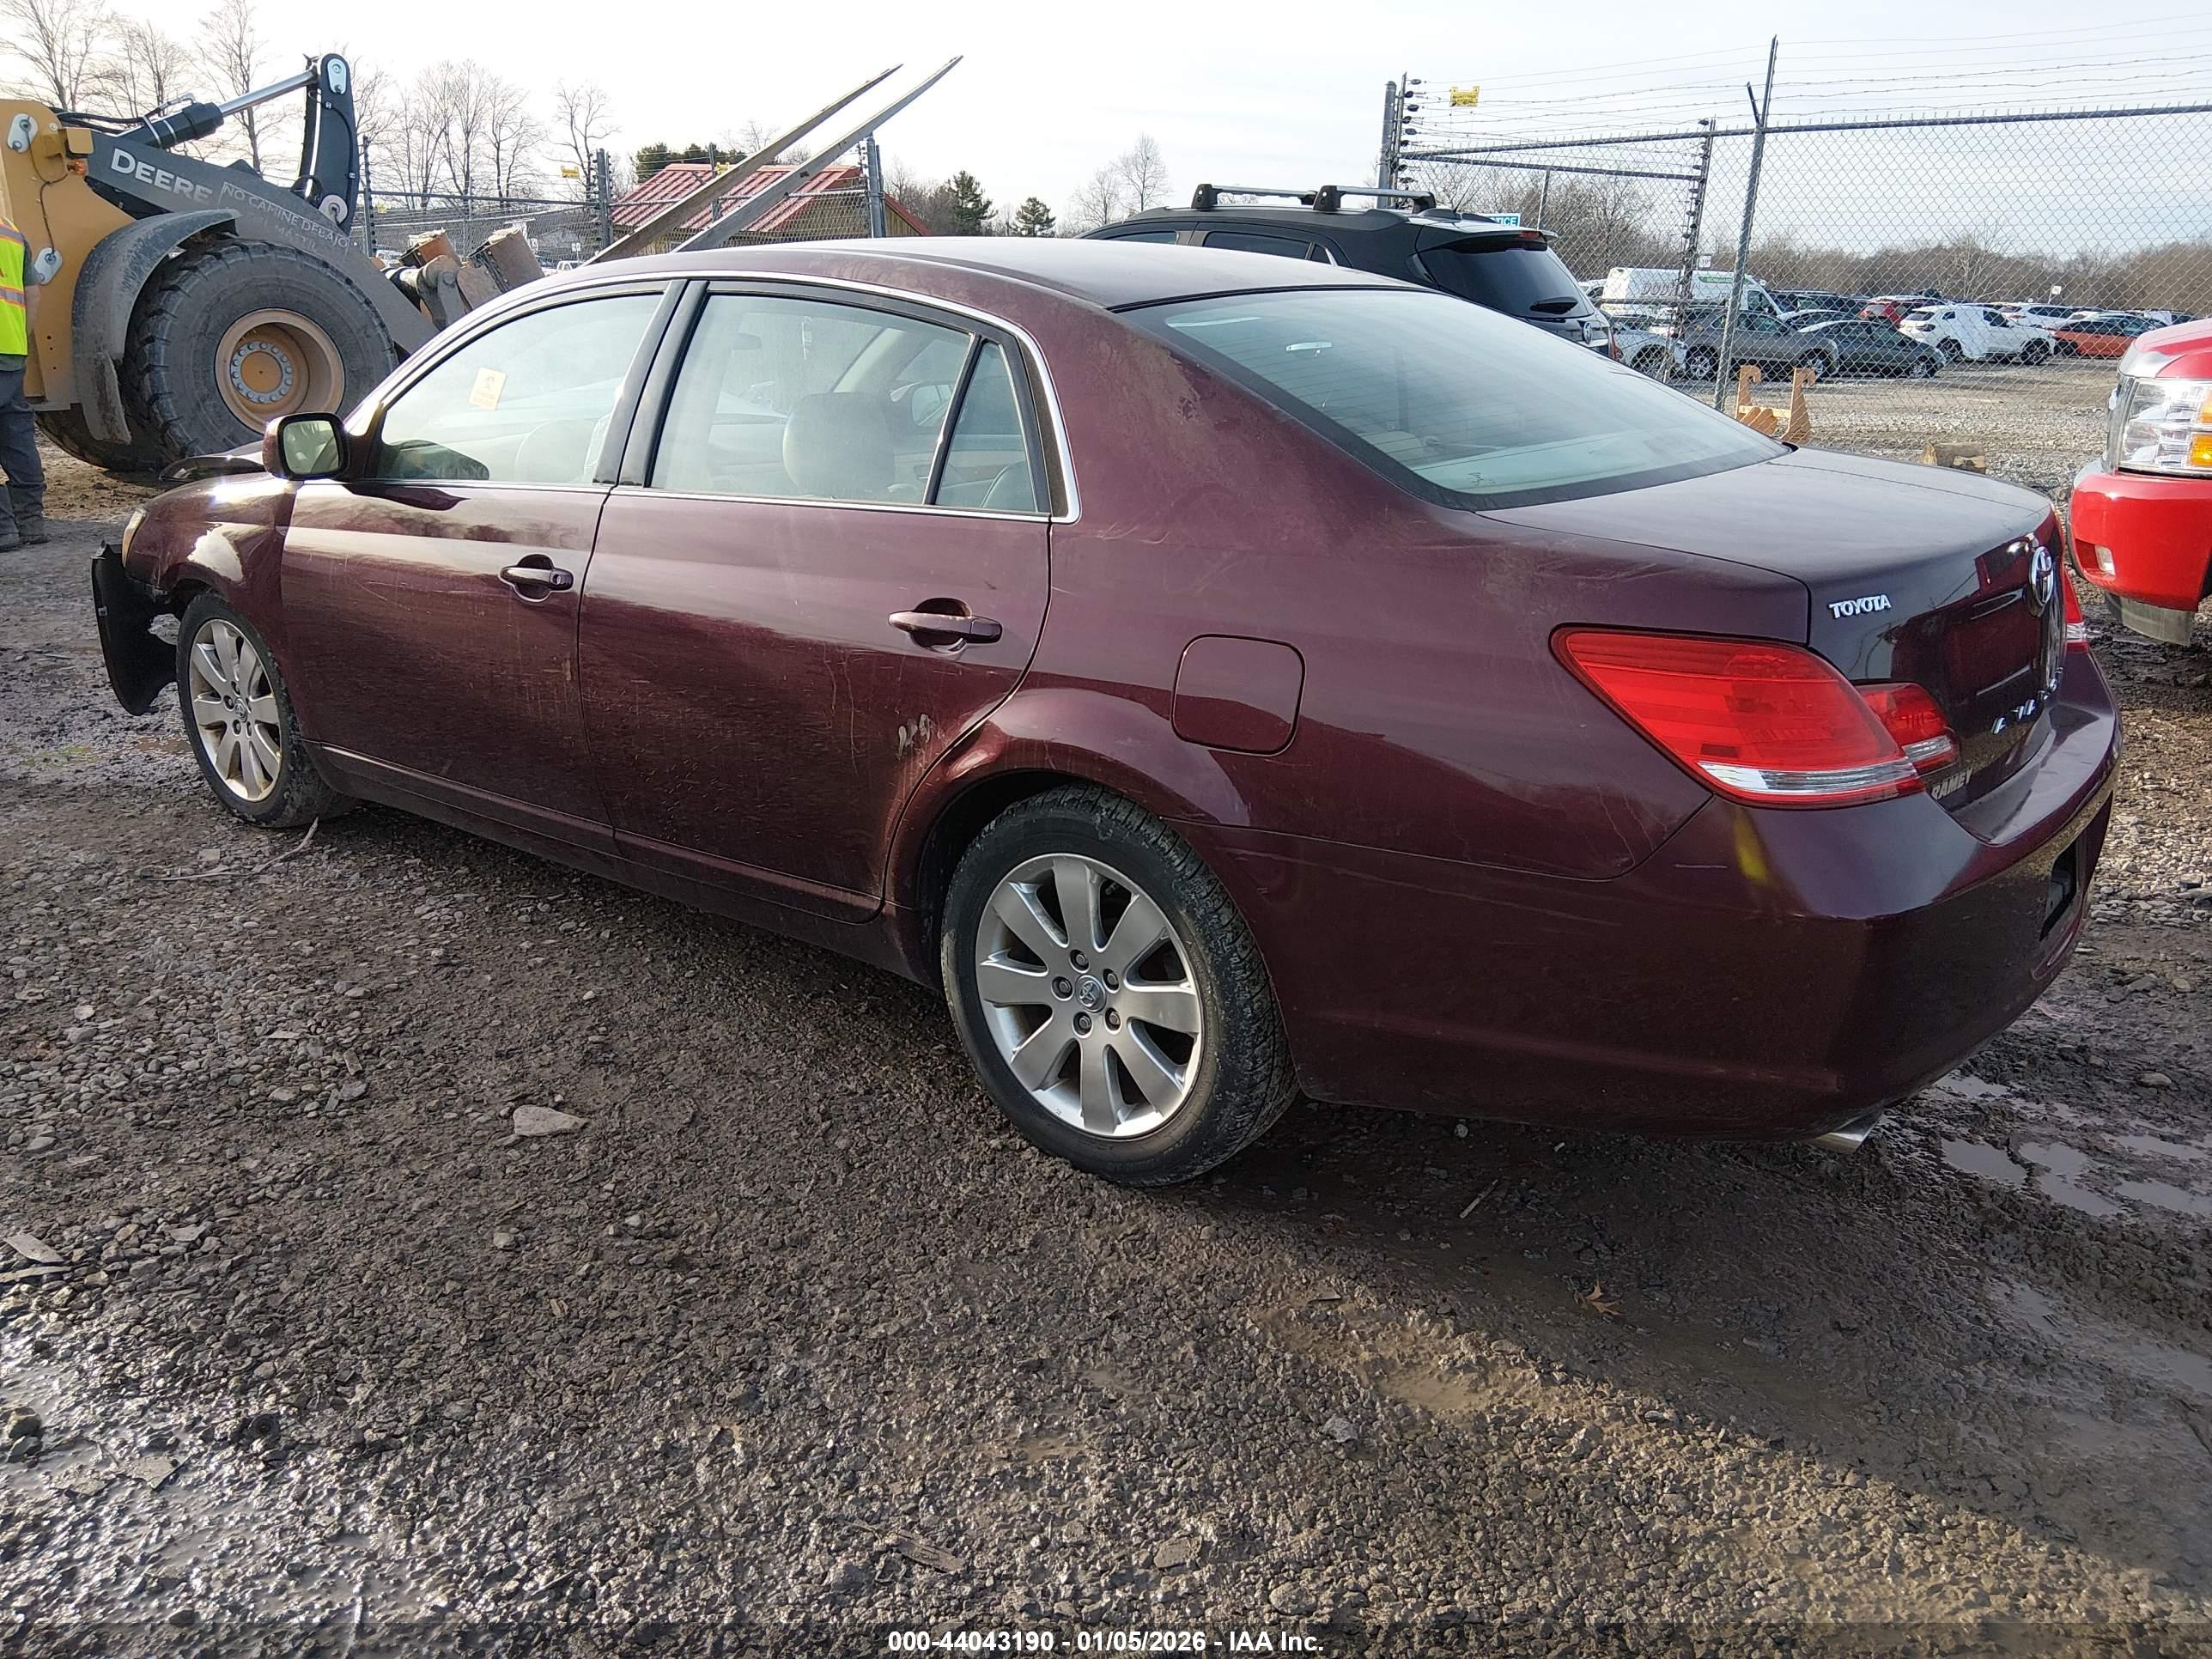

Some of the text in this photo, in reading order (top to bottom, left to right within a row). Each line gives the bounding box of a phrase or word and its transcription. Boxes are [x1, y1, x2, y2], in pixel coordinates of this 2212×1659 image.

[111, 148, 213, 205] DEERE
[223, 184, 246, 201] NO
[248, 197, 301, 227] CAMINE
[1490, 216, 1516, 227] TICE
[1828, 594, 1892, 618] TOYOTA
[1931, 767, 1973, 800] RAMEY
